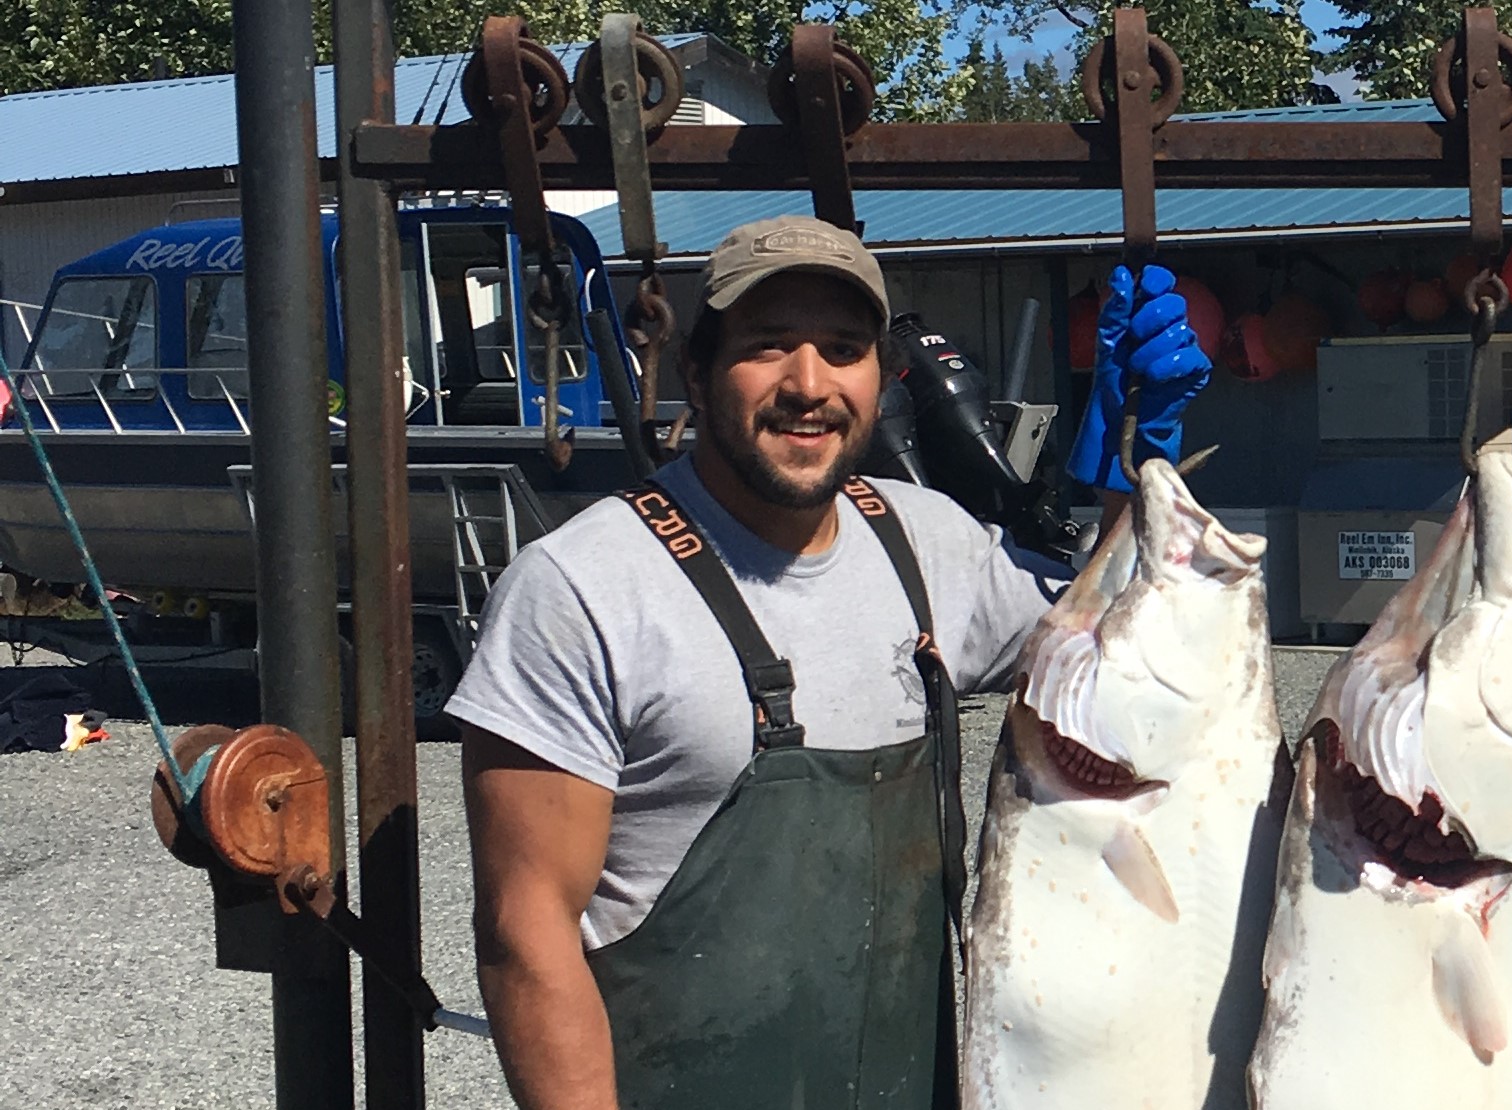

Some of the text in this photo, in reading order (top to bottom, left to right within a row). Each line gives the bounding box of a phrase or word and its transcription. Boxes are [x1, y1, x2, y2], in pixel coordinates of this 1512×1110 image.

[126, 236, 211, 271] Reel
[1344, 555, 1411, 570] AKS 003068
